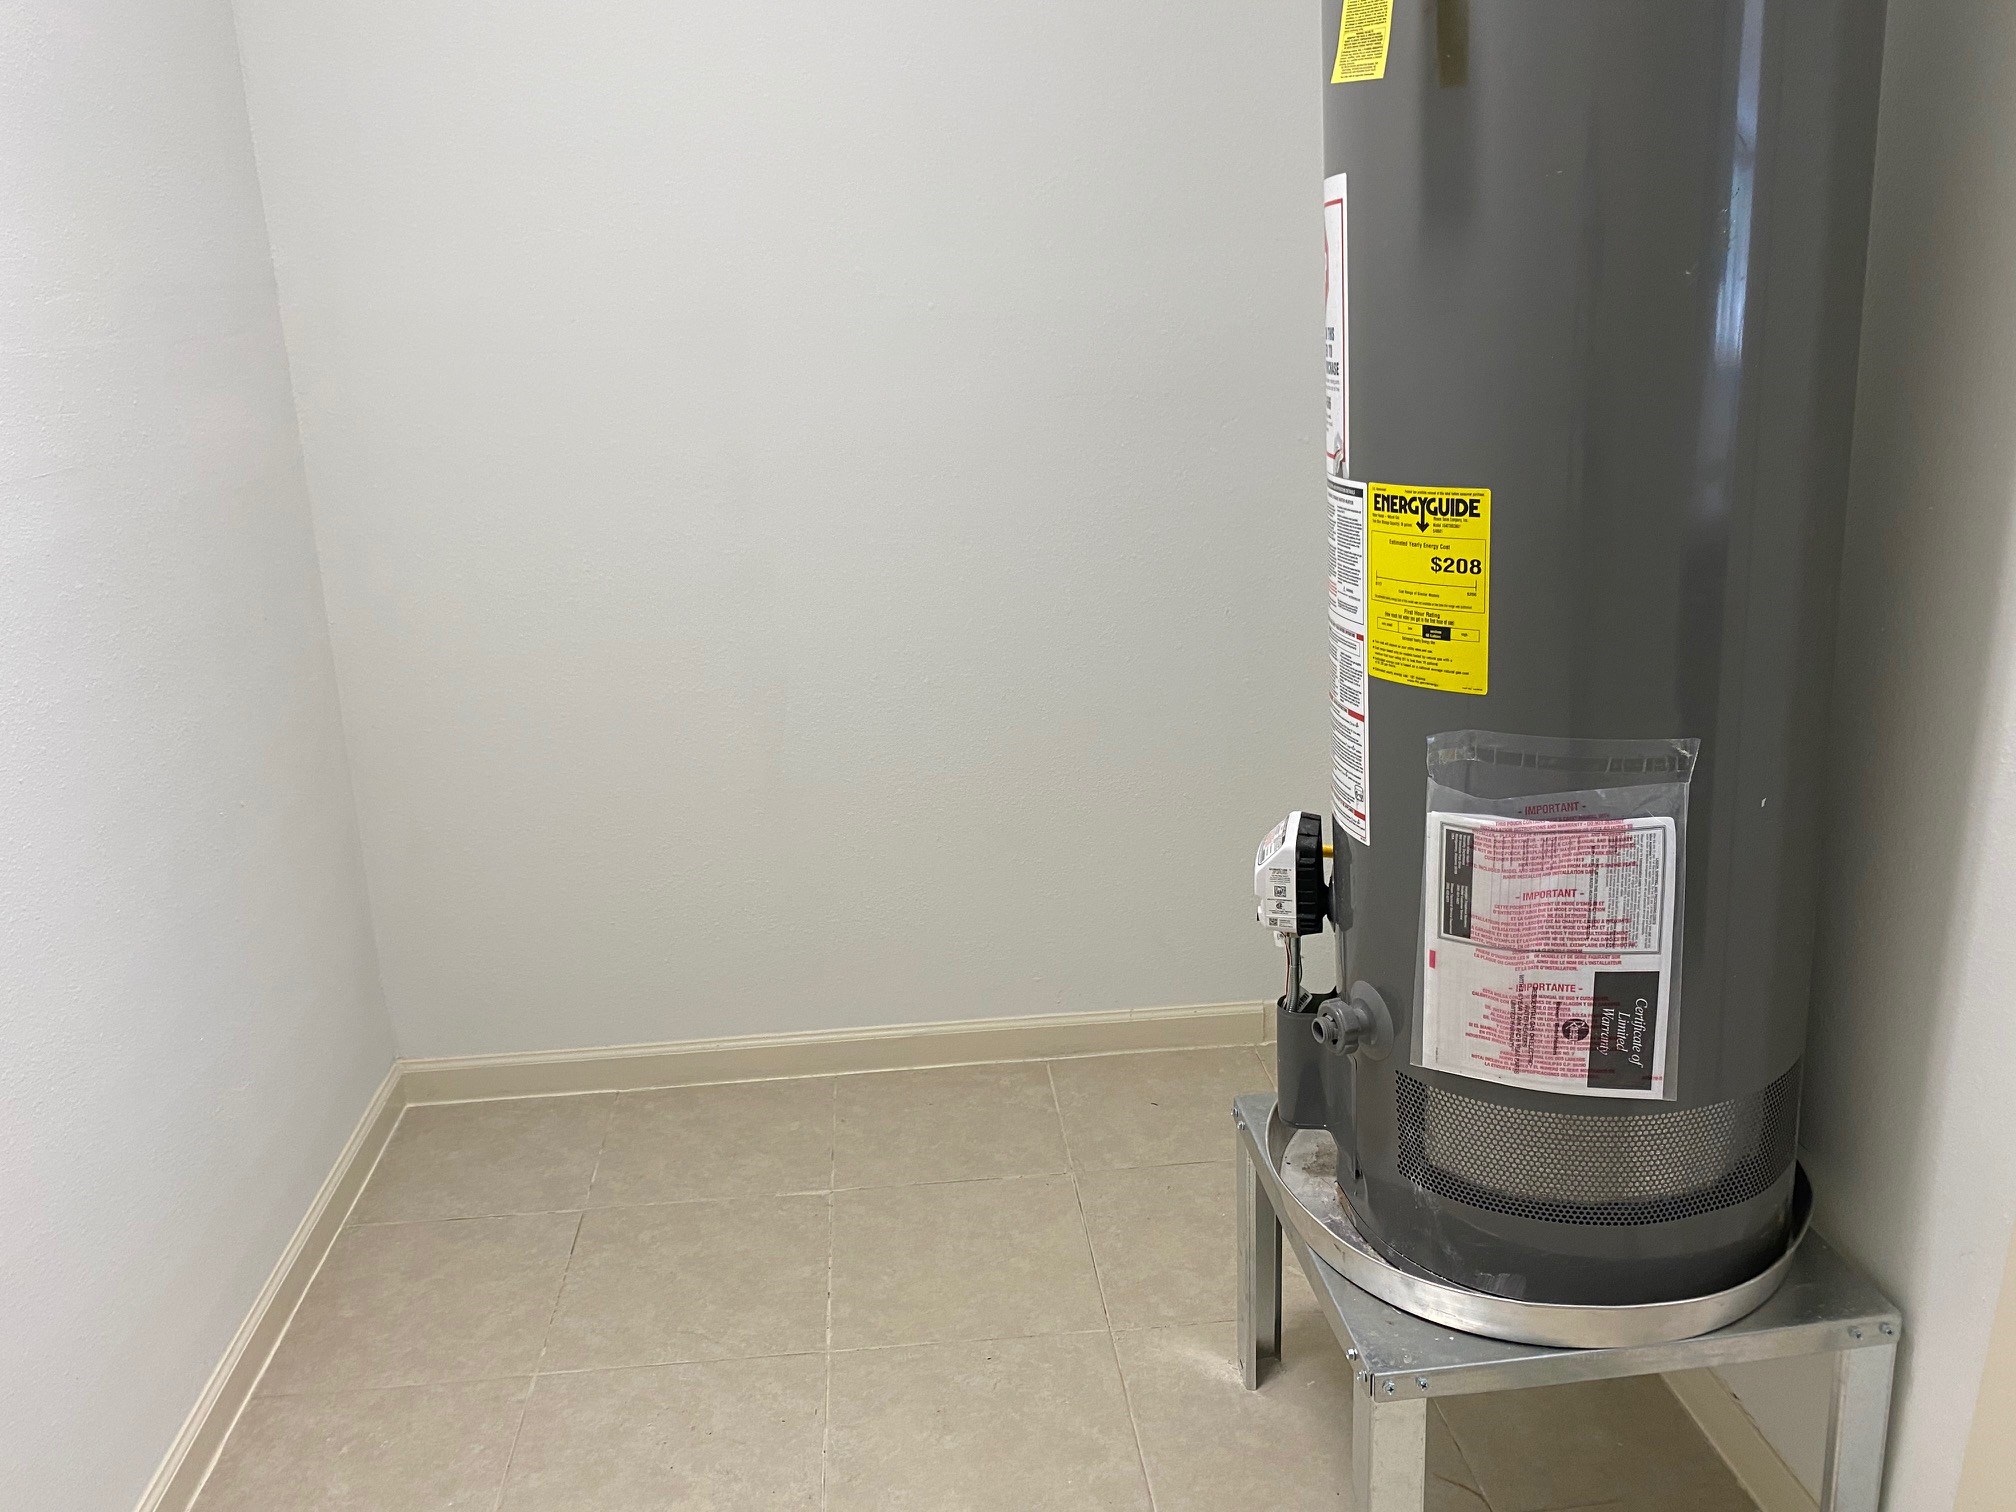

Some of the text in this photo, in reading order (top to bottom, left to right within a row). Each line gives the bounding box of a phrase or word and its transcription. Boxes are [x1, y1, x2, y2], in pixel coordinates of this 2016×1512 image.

[1374, 494, 1480, 518] ENERGYGUIDE
[1430, 556, 1482, 575] $208
[1524, 802, 1580, 815] IMPORTANT
[1522, 889, 1577, 901] IMPORTANT
[1516, 983, 1576, 993] IMPORTANTE
[1597, 1008, 1614, 1056] Warranty
[1616, 1012, 1630, 1052] Limited
[1629, 998, 1648, 1068] Certificate of
